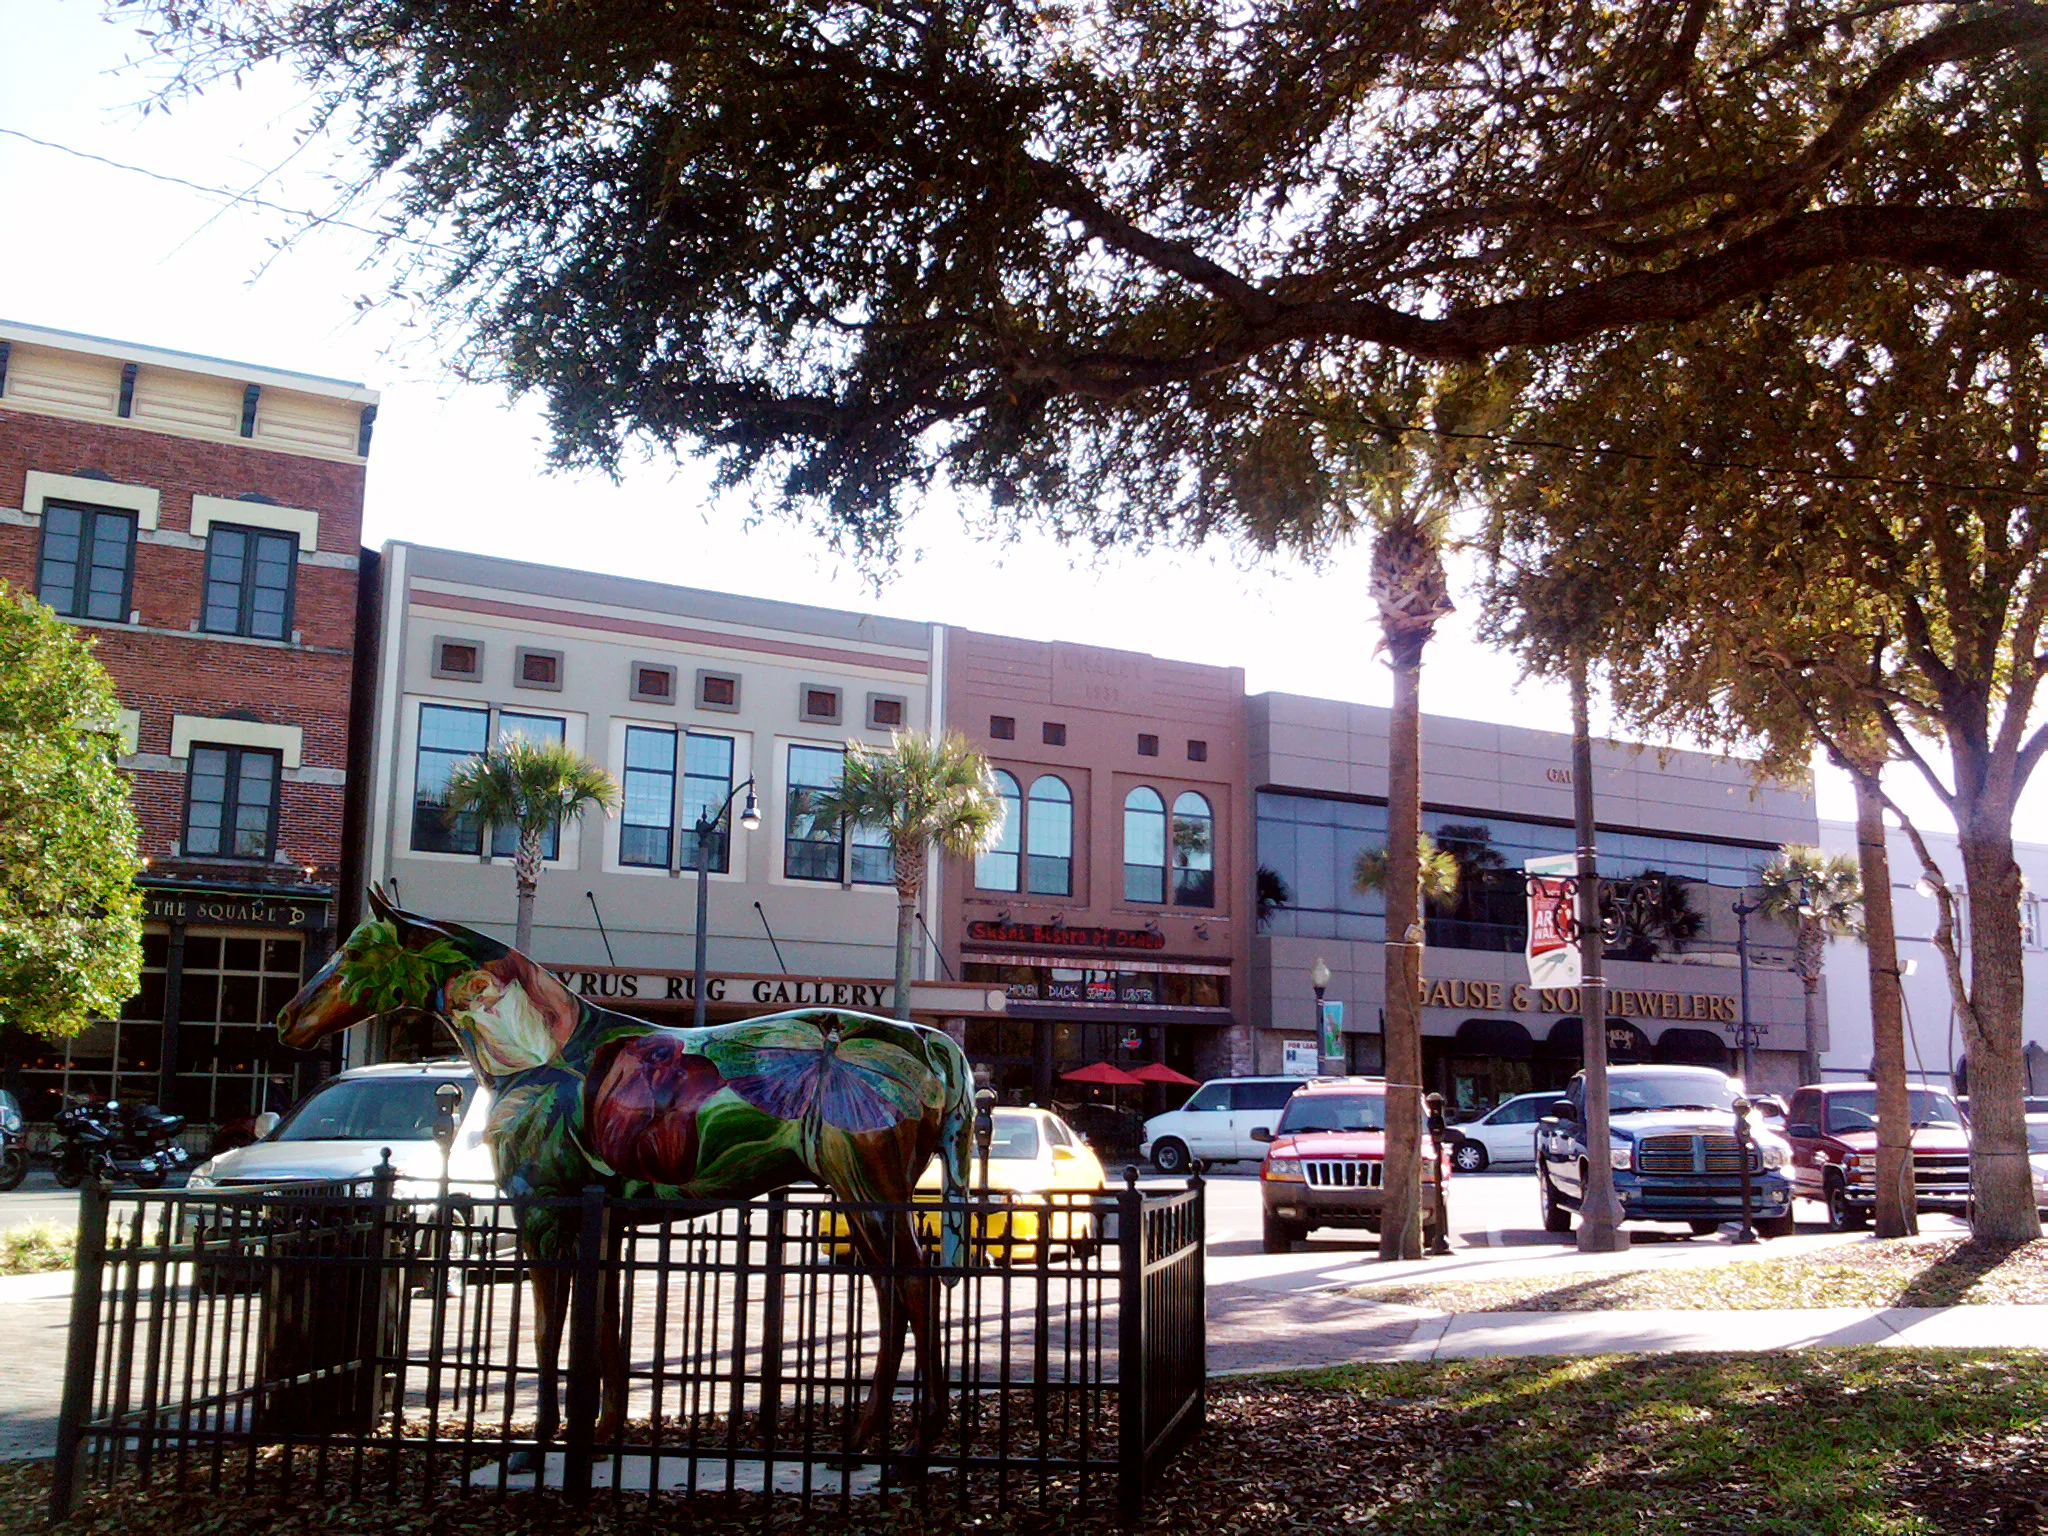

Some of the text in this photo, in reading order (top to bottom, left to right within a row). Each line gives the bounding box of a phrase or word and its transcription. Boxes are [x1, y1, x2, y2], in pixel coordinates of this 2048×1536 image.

[152, 900, 276, 922] THE SQUARE
[554, 971, 887, 1007] YRUS RUG GALLERY
[1048, 985, 1079, 998] DUCK
[1512, 983, 1531, 1012] &
[1606, 989, 1737, 1021] JEWELERS
